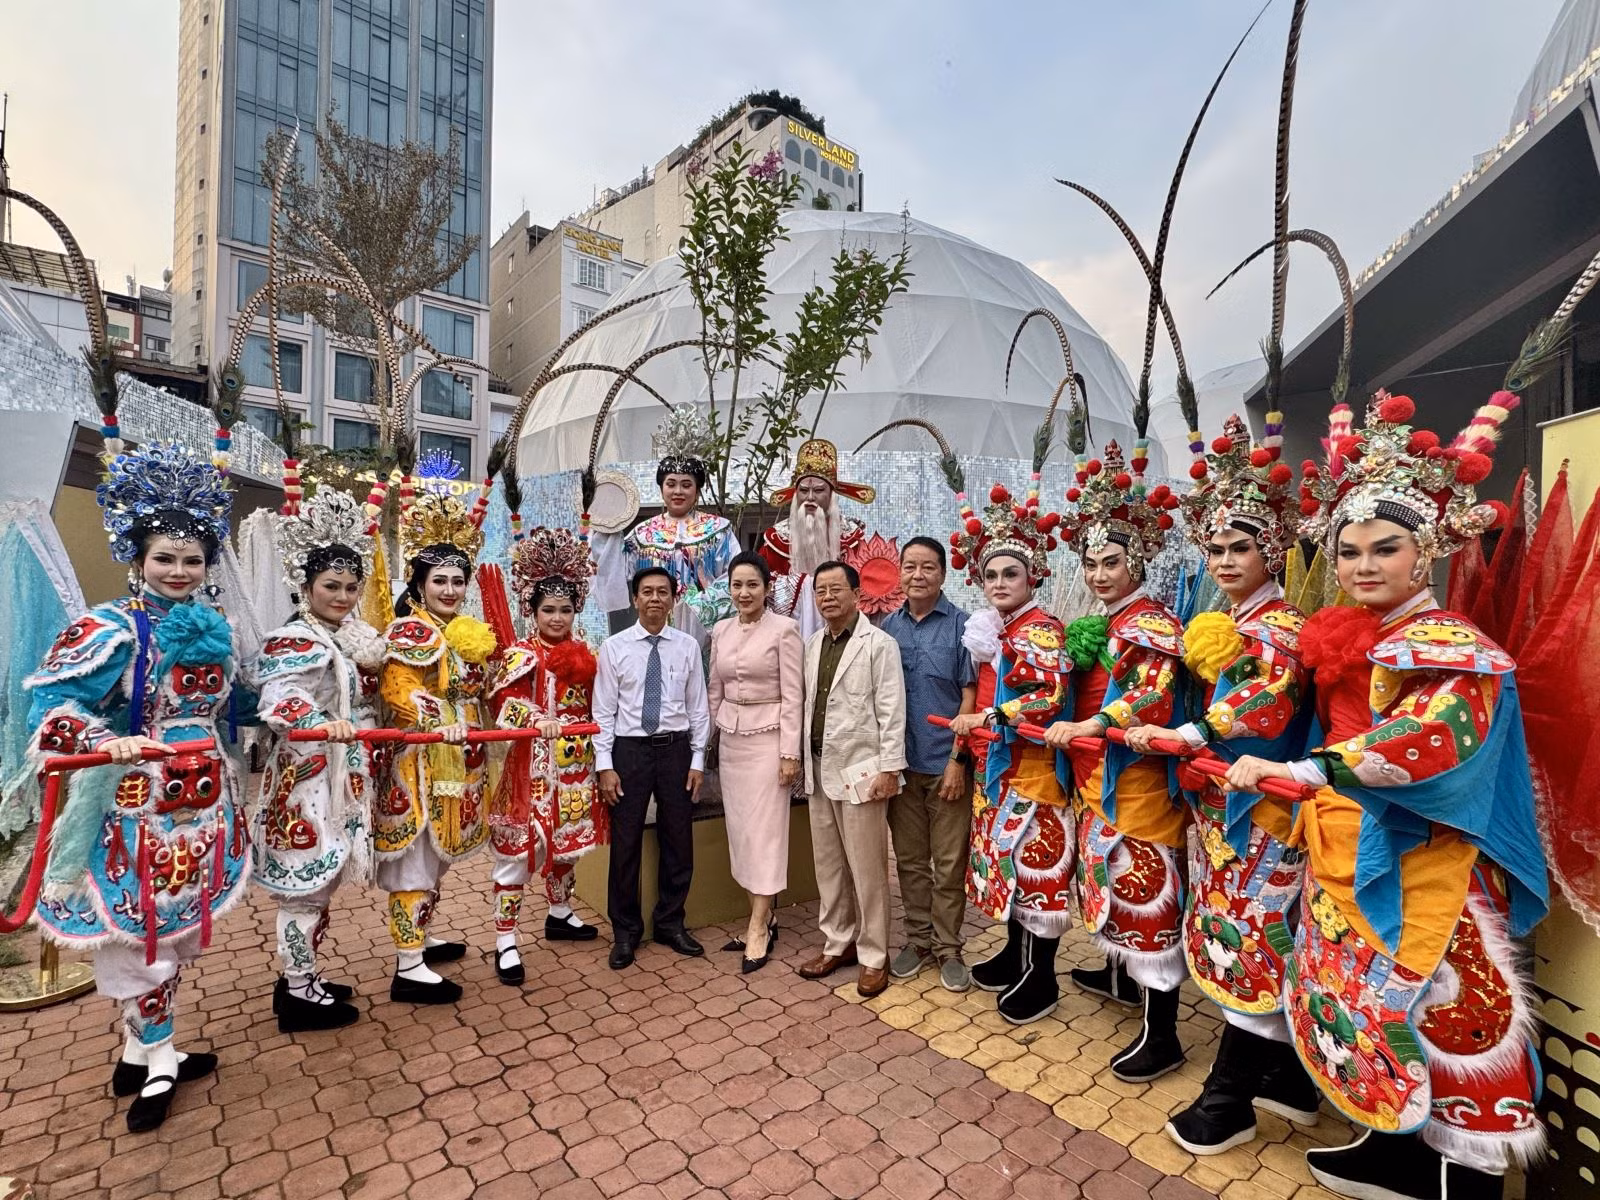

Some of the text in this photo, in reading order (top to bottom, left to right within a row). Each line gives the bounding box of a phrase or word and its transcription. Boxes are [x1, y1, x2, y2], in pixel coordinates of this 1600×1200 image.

[788, 120, 855, 164] SILVERLAND
[820, 150, 854, 172] HOSPITALITY
[576, 242, 613, 261] HOTEL
